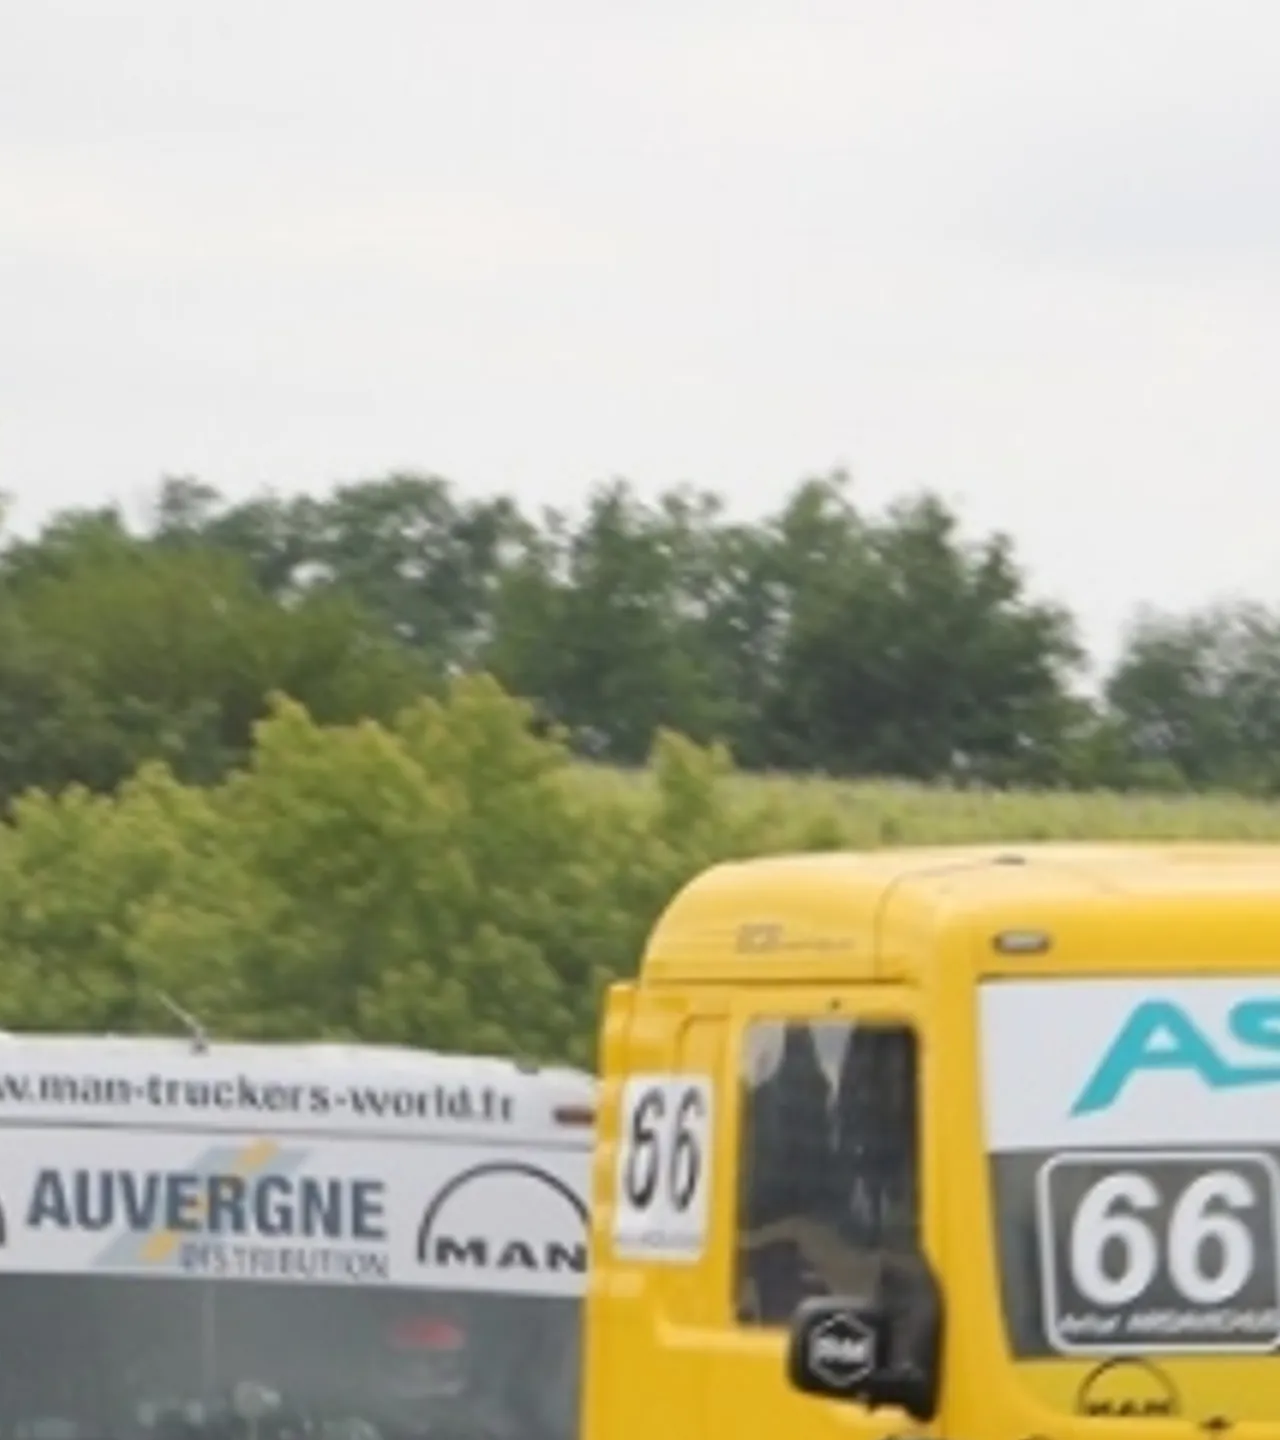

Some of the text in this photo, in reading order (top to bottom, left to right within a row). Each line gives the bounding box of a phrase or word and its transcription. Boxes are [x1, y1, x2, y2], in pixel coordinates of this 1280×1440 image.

[624, 1087, 704, 1213] 66
[27, 1168, 388, 1241] AUVERGNE
[1068, 1172, 1258, 1307] 66
[434, 1239, 586, 1273] MAN
